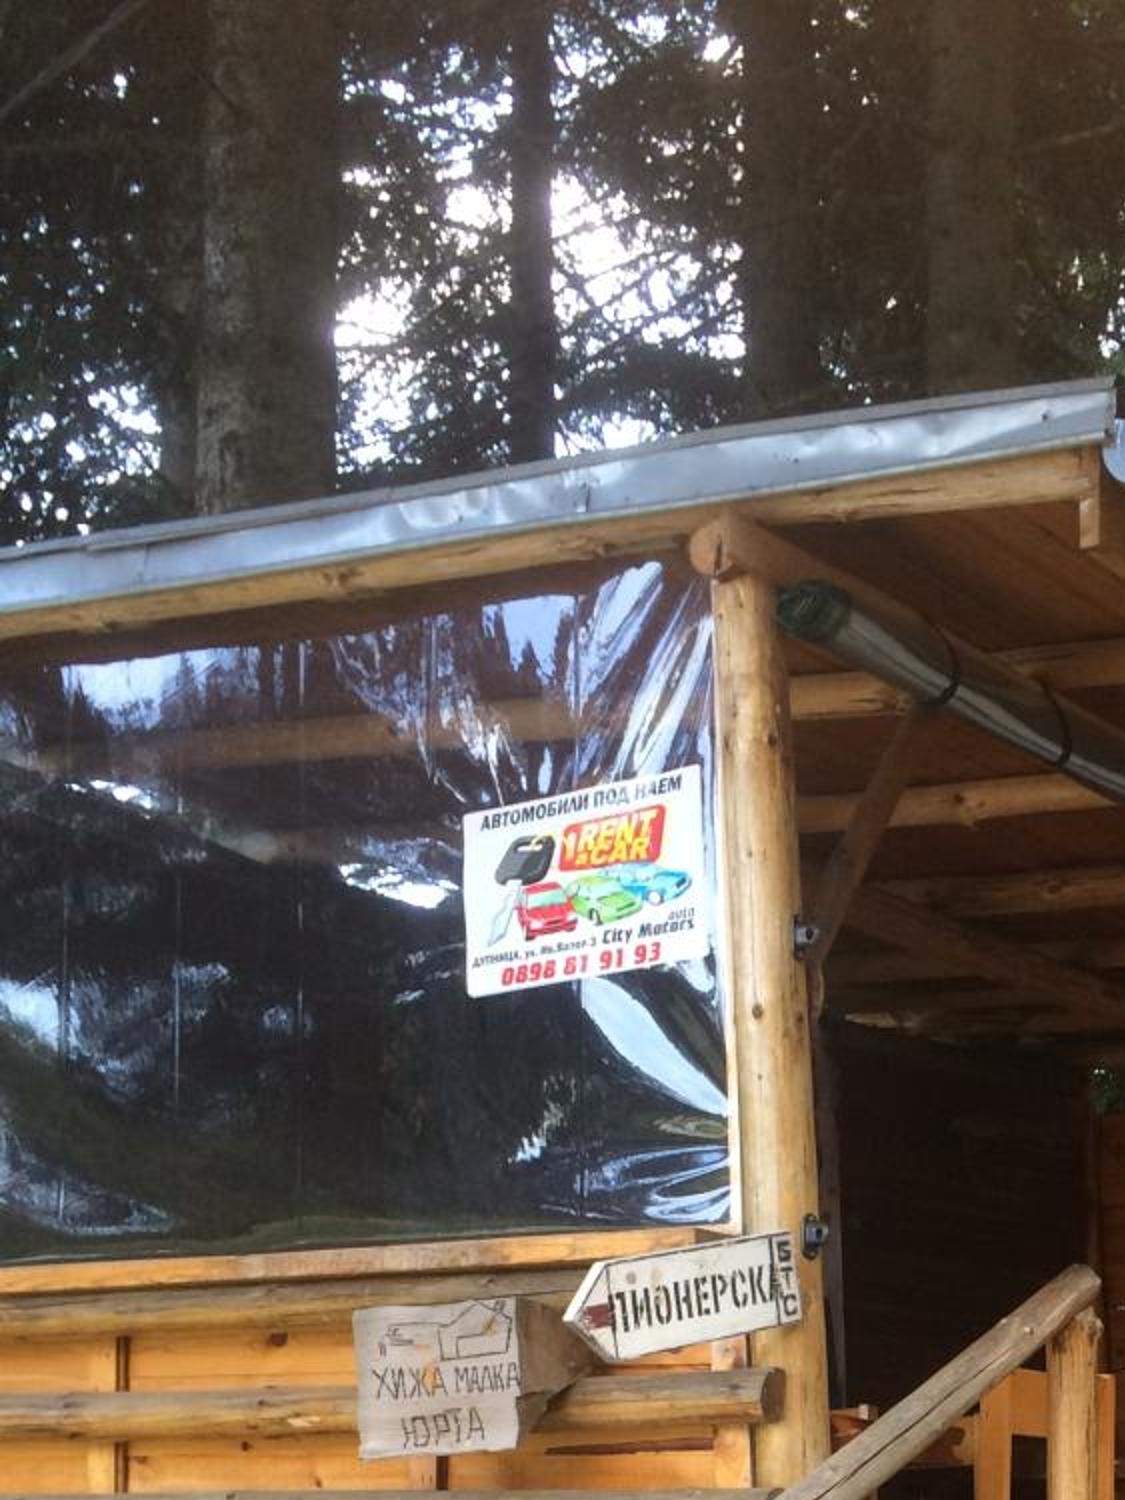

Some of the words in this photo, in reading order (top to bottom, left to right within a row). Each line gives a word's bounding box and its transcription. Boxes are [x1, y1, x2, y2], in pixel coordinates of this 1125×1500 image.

[481, 794, 590, 832] АВТОМОБИЛИ
[593, 786, 631, 807] ПОД
[635, 774, 683, 800] НАЕМ
[578, 809, 658, 851] RENT
[590, 836, 651, 864] CAR
[602, 926, 633, 945] City
[638, 918, 695, 939] Motors
[501, 960, 557, 986] 0898
[599, 948, 624, 970] 91
[633, 942, 662, 965] 93
[371, 1365, 449, 1401] ХИЖА
[453, 1361, 522, 1394] МАЛКА
[400, 1405, 486, 1449] ЮРТА
